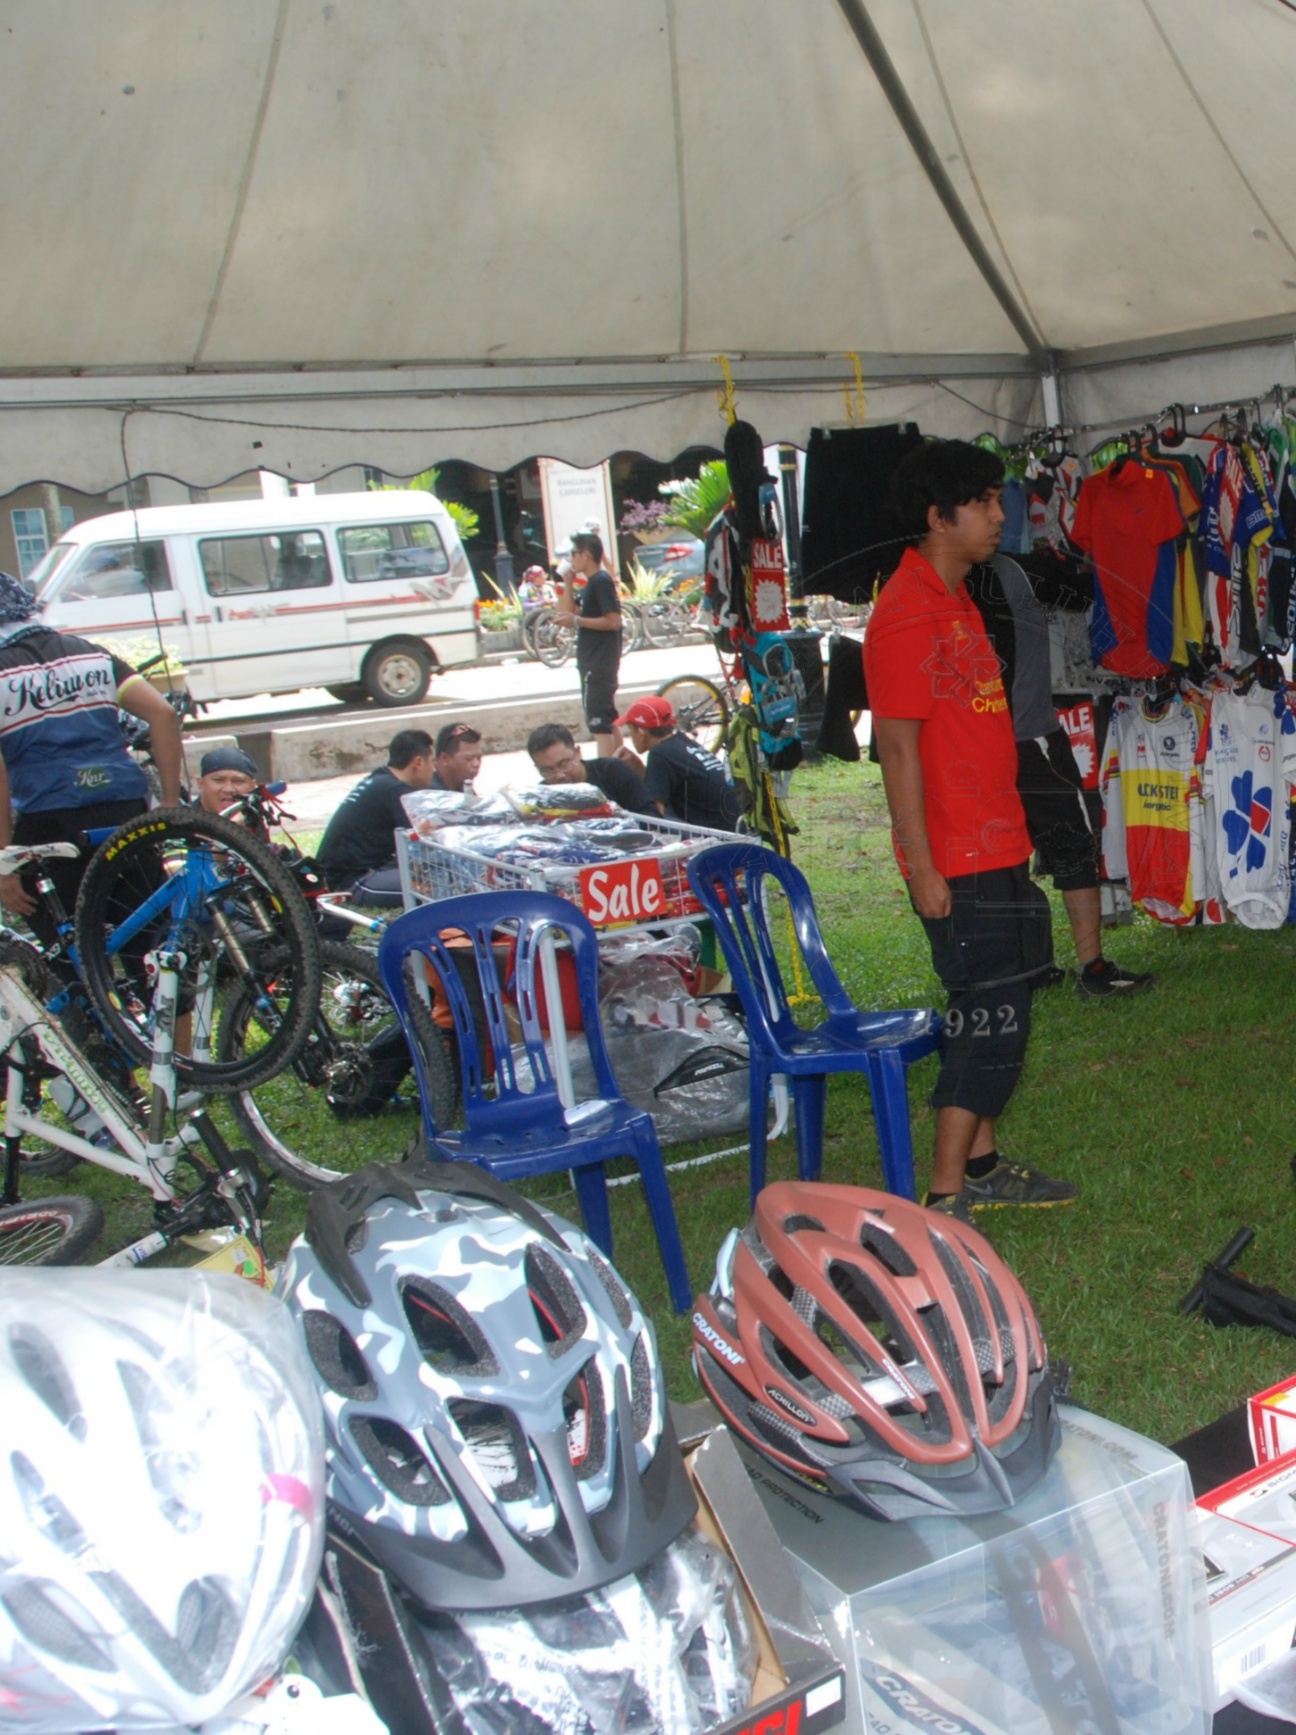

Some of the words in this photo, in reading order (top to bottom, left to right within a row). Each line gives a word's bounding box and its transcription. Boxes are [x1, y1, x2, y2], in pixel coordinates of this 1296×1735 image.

[753, 542, 783, 569] SALE
[1058, 706, 1092, 737] ALE
[106, 821, 167, 862] MAXXIS
[587, 863, 661, 922] Sale
[692, 1311, 743, 1366] CRATONI
[1062, 1418, 1139, 1462] RATONI.COM
[760, 1477, 825, 1525] PROTECTION
